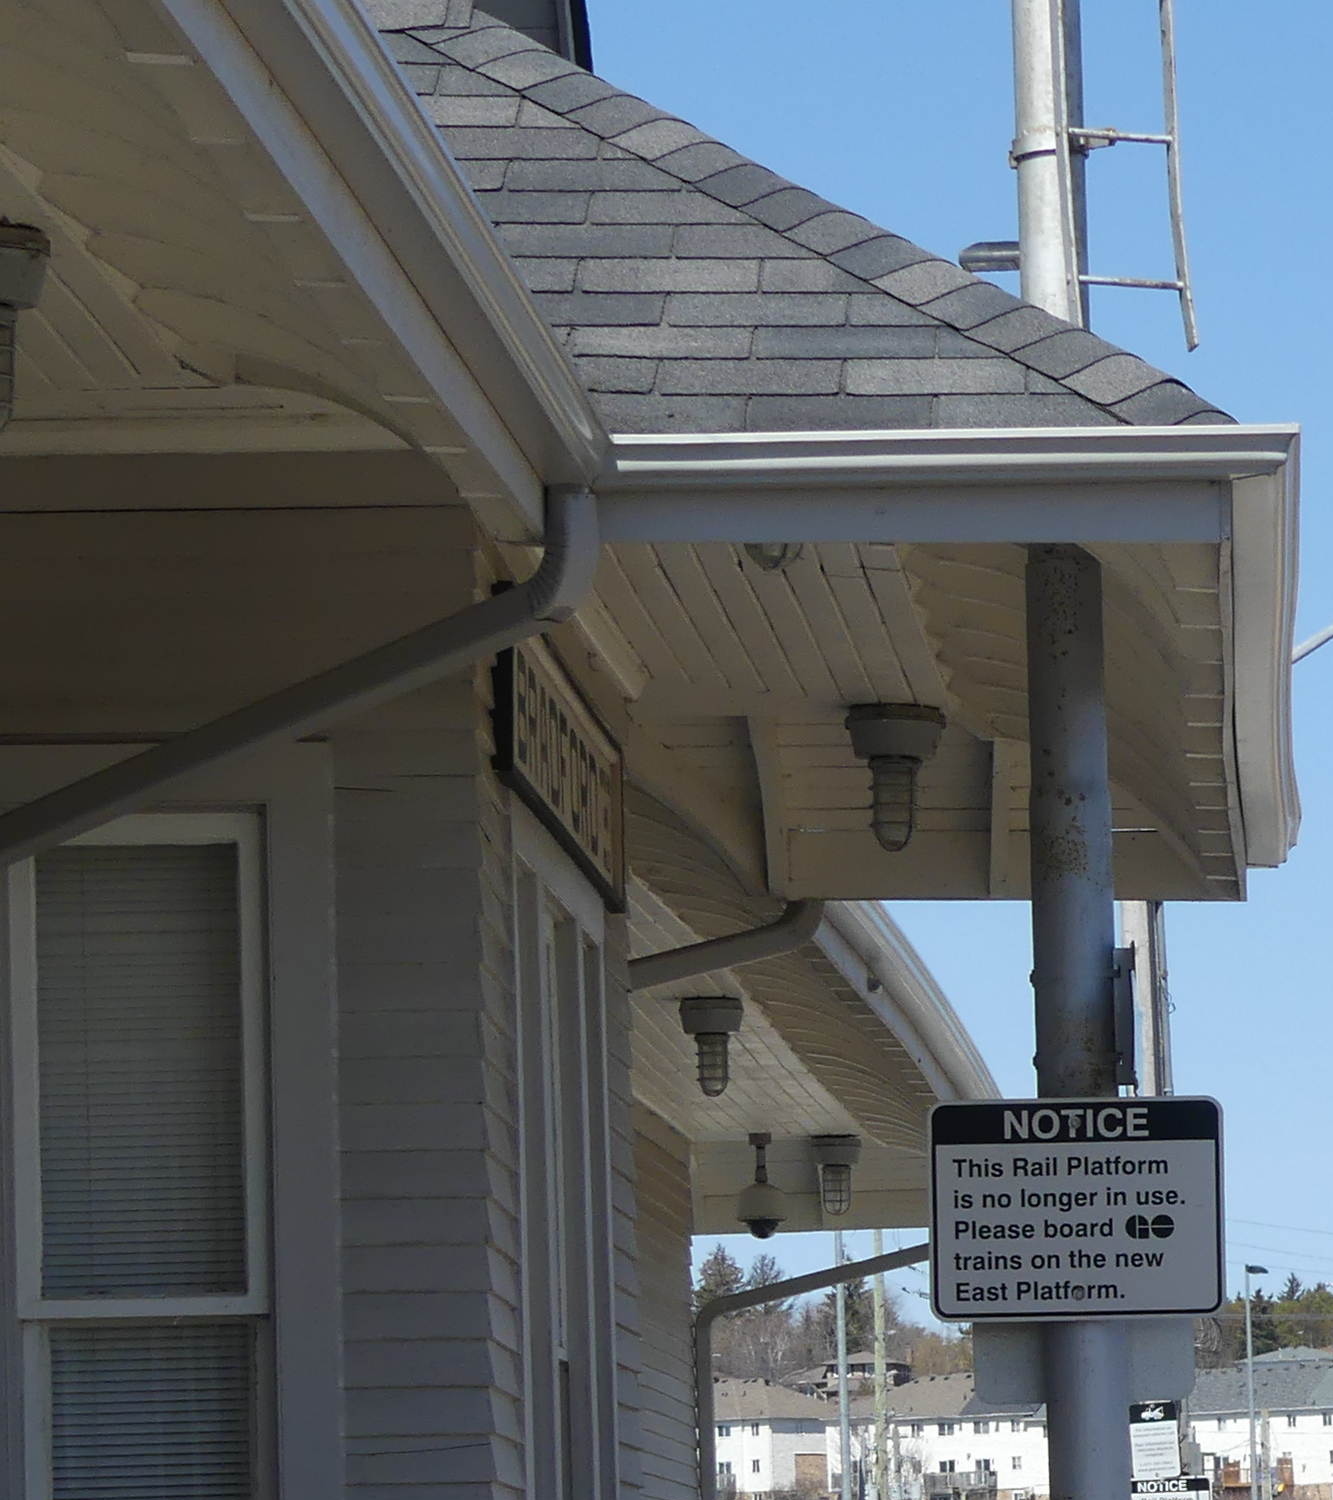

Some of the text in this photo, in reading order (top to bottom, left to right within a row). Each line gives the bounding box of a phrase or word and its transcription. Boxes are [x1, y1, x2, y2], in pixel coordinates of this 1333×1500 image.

[1003, 1107, 1150, 1140] NOTICE
[952, 1155, 1169, 1179] This Rail Platform
[953, 1187, 1186, 1212] is no longer in use.
[954, 1219, 1035, 1240] Please
[1044, 1218, 1114, 1239] board
[954, 1250, 1164, 1271] trains on the new
[956, 1280, 1126, 1302] East Platform.
[1137, 1480, 1188, 1493] NOTICE
